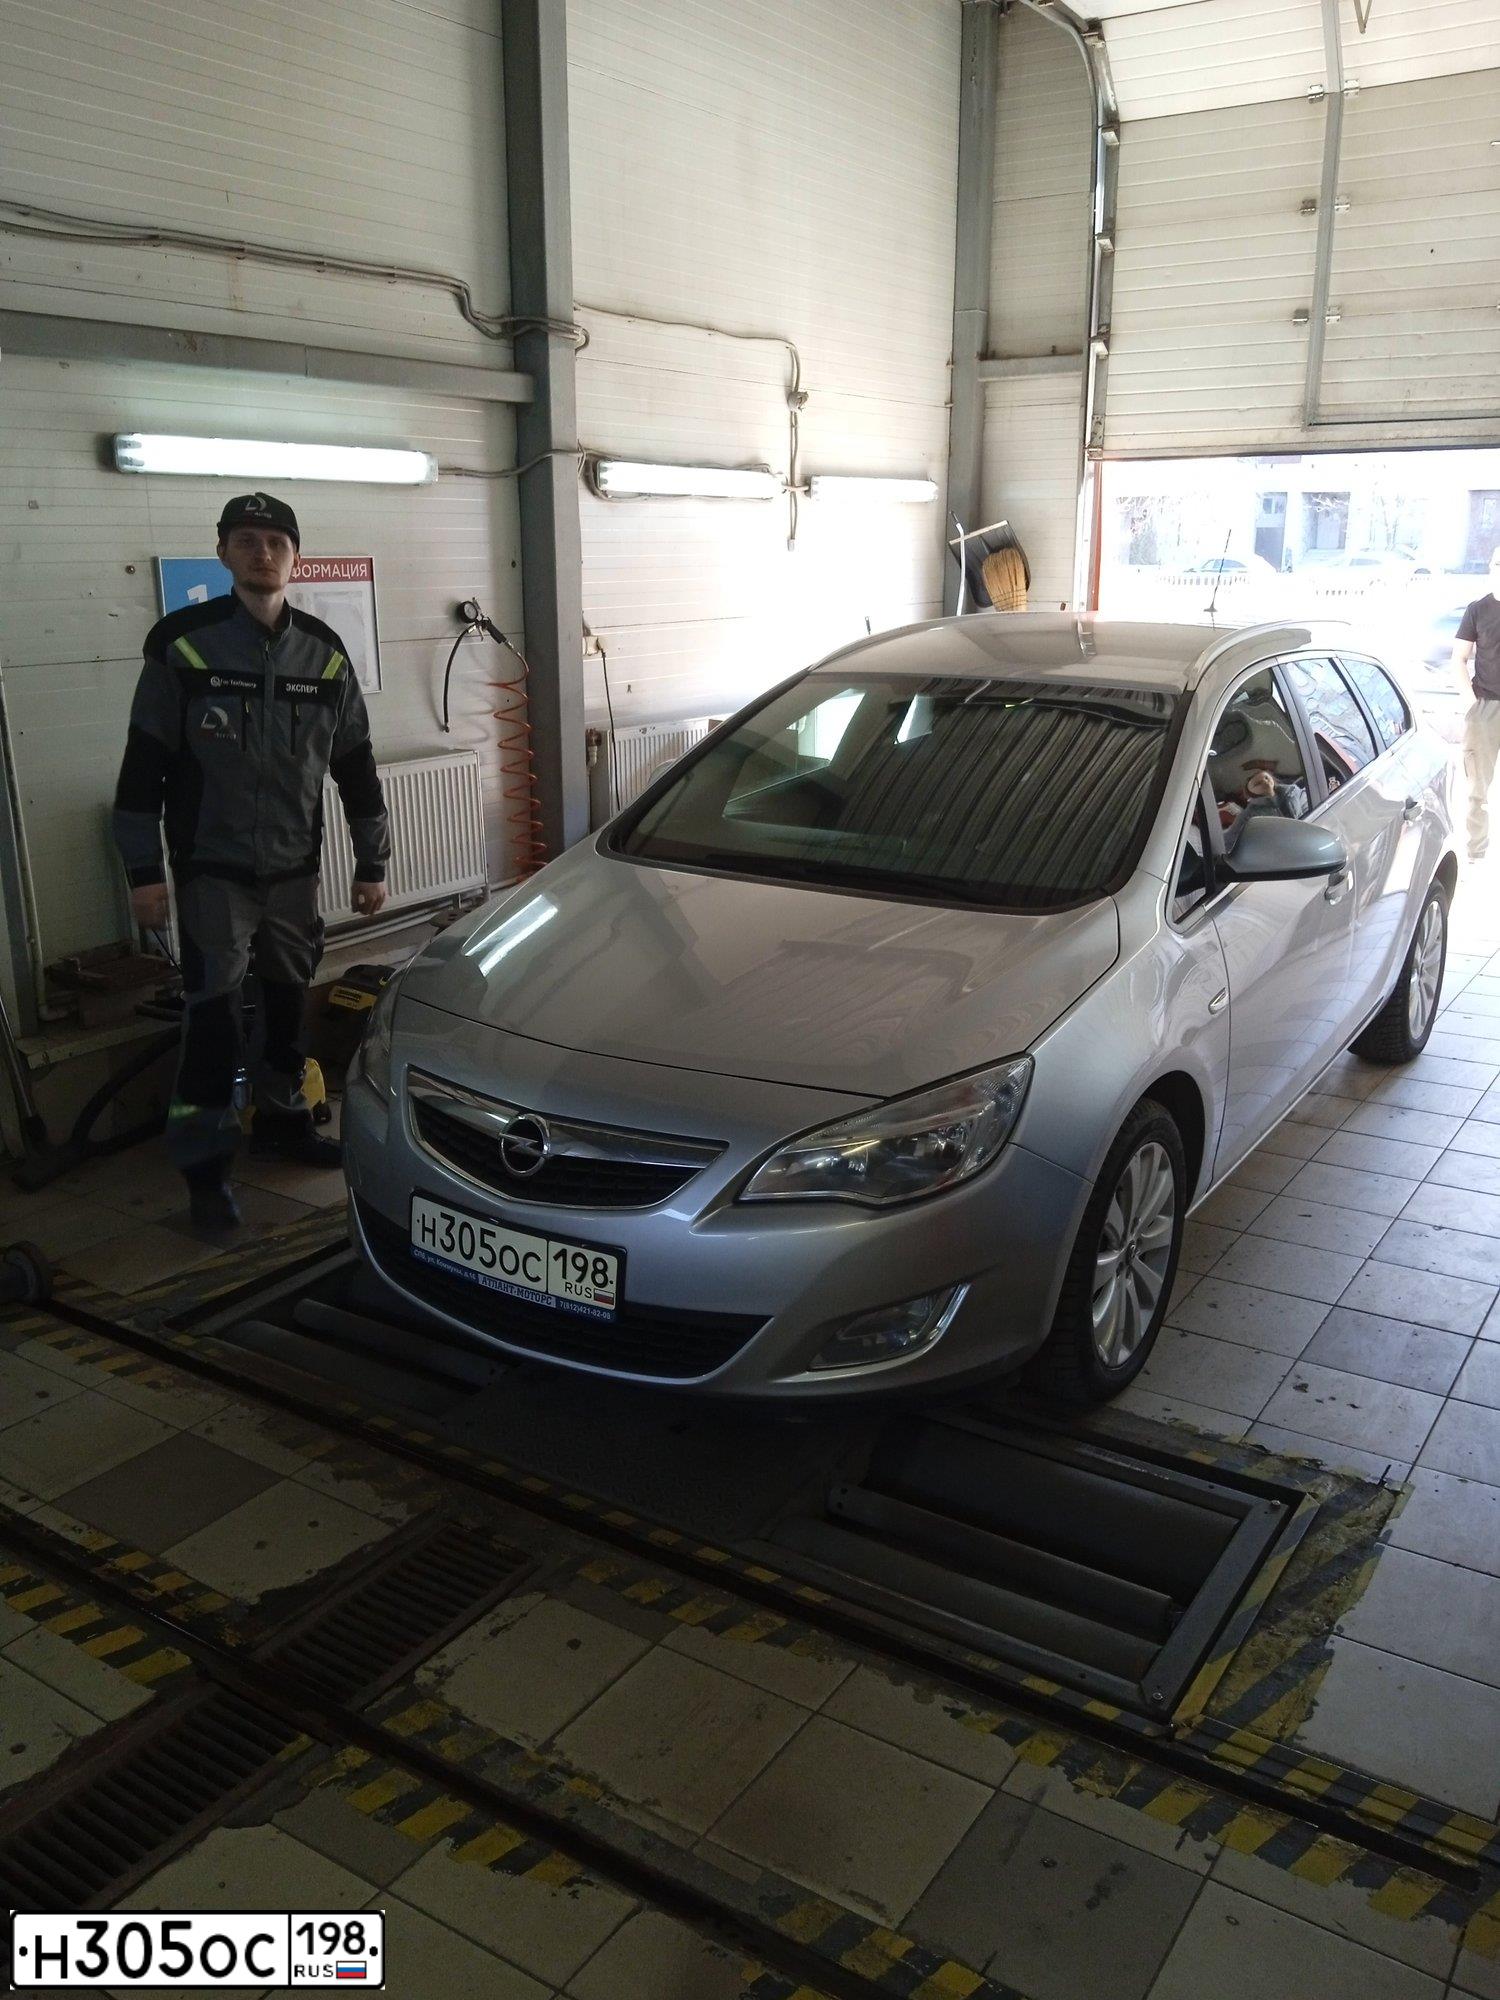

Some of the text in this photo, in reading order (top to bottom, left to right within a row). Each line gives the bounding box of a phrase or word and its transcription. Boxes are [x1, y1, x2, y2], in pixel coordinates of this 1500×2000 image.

[292, 563, 368, 579] ФОРМАЦИЯ
[286, 683, 319, 694] ЭКСПЕРТ
[421, 1212, 609, 1289] Н305ОС 198
[565, 1282, 593, 1299] RUS
